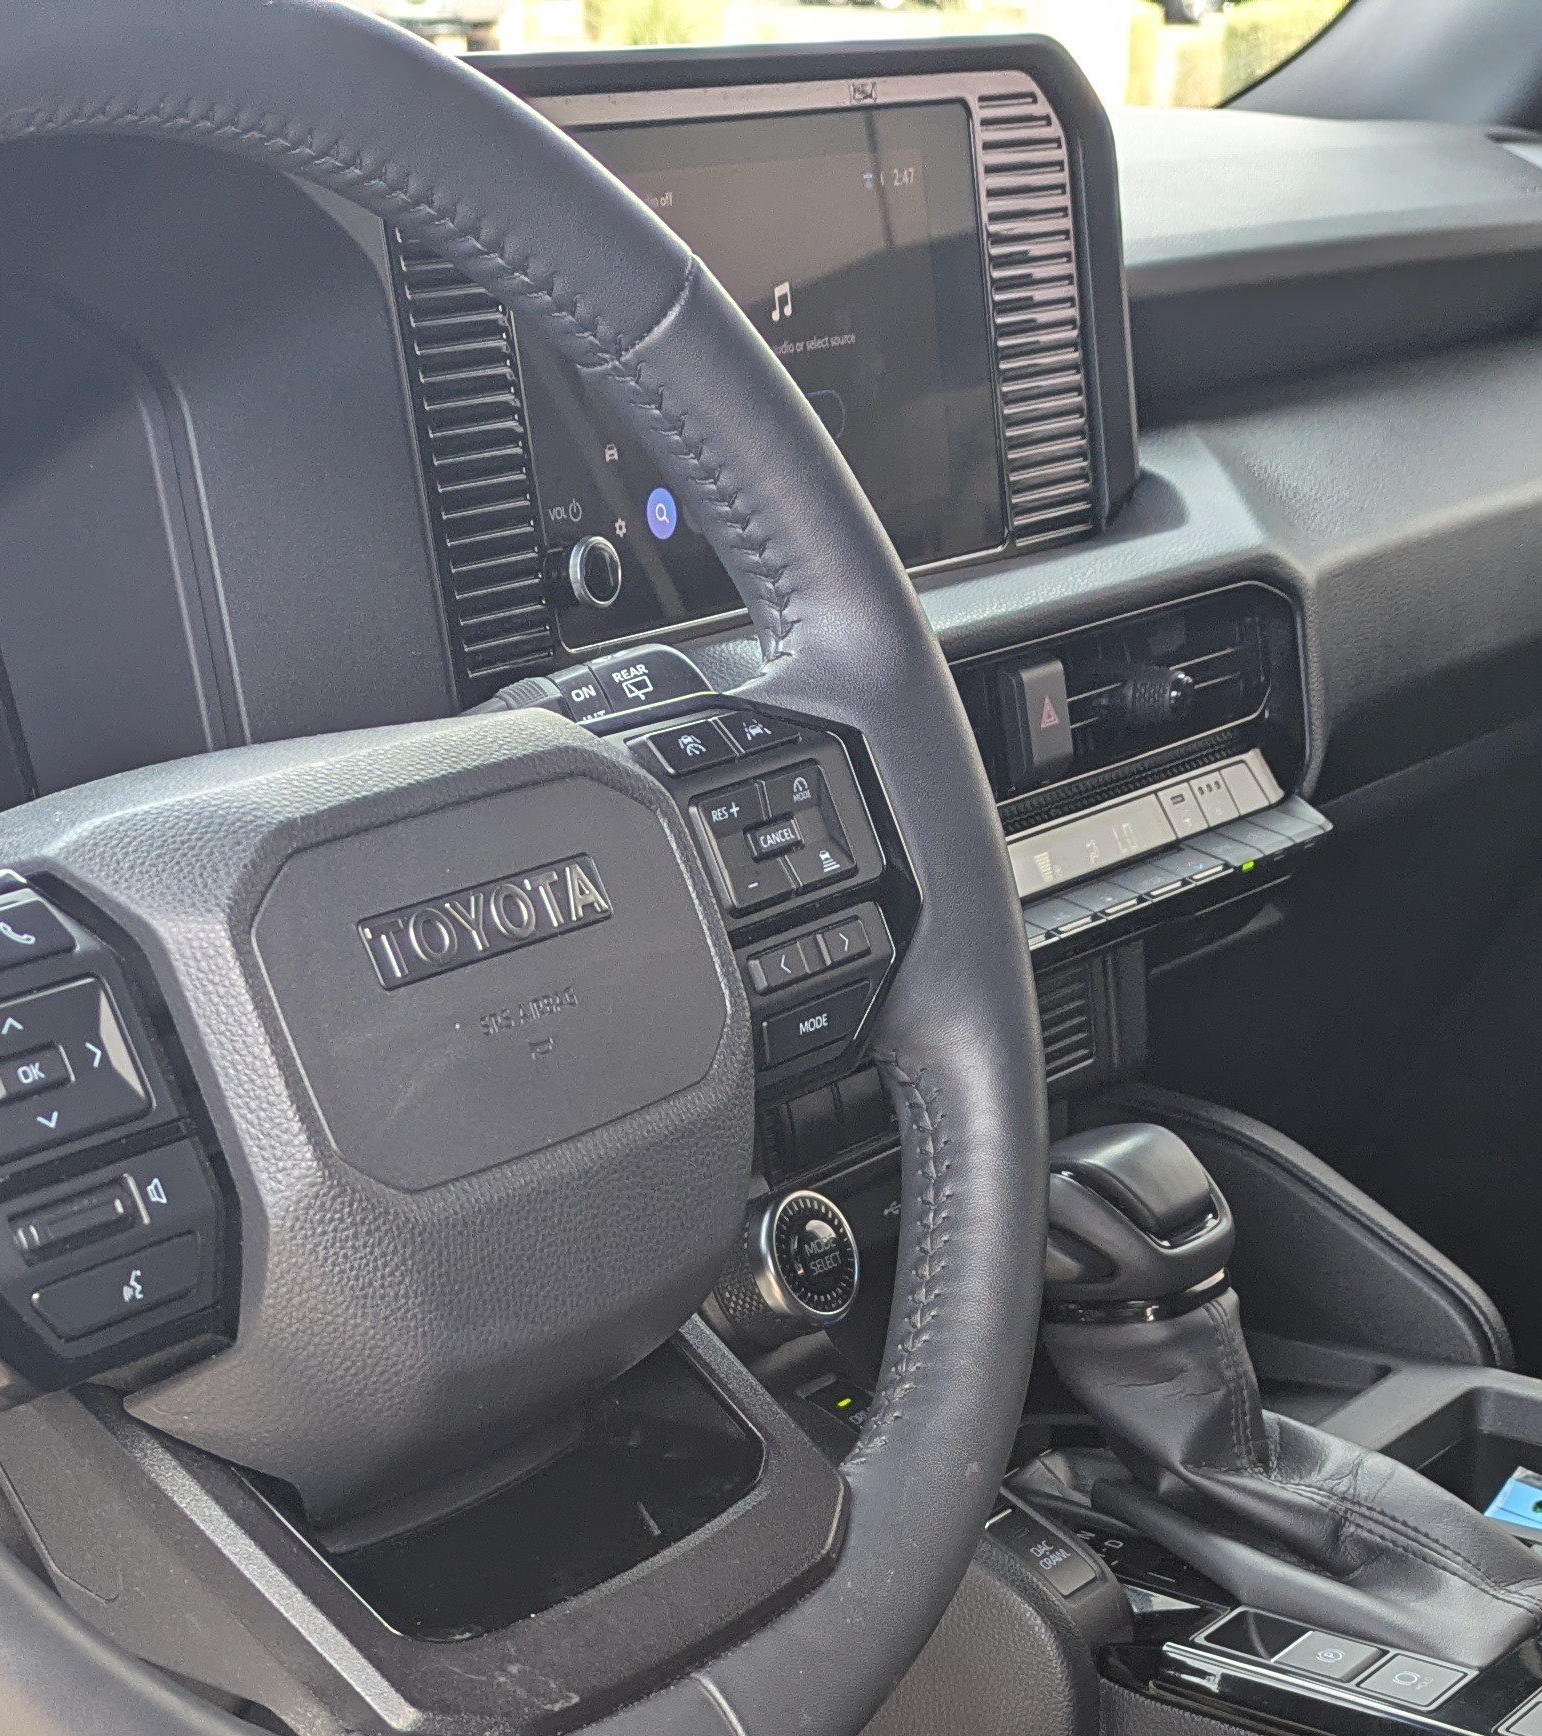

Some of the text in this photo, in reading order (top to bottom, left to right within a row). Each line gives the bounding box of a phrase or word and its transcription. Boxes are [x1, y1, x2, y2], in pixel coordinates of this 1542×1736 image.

[892, 166, 916, 188] 2:47
[548, 505, 568, 523] VOL
[611, 664, 648, 683] REAR
[571, 685, 596, 702] ON
[760, 827, 796, 849] CANCEL
[364, 858, 610, 979] TOYOTA
[481, 1010, 513, 1037] SRS
[798, 1011, 829, 1037] MODE
[17, 1060, 46, 1086] OK
[804, 1236, 838, 1258] MODE
[809, 1252, 843, 1277] SELECT
[1029, 1538, 1054, 1559] DAC
[1039, 1547, 1073, 1572] CRAWL
